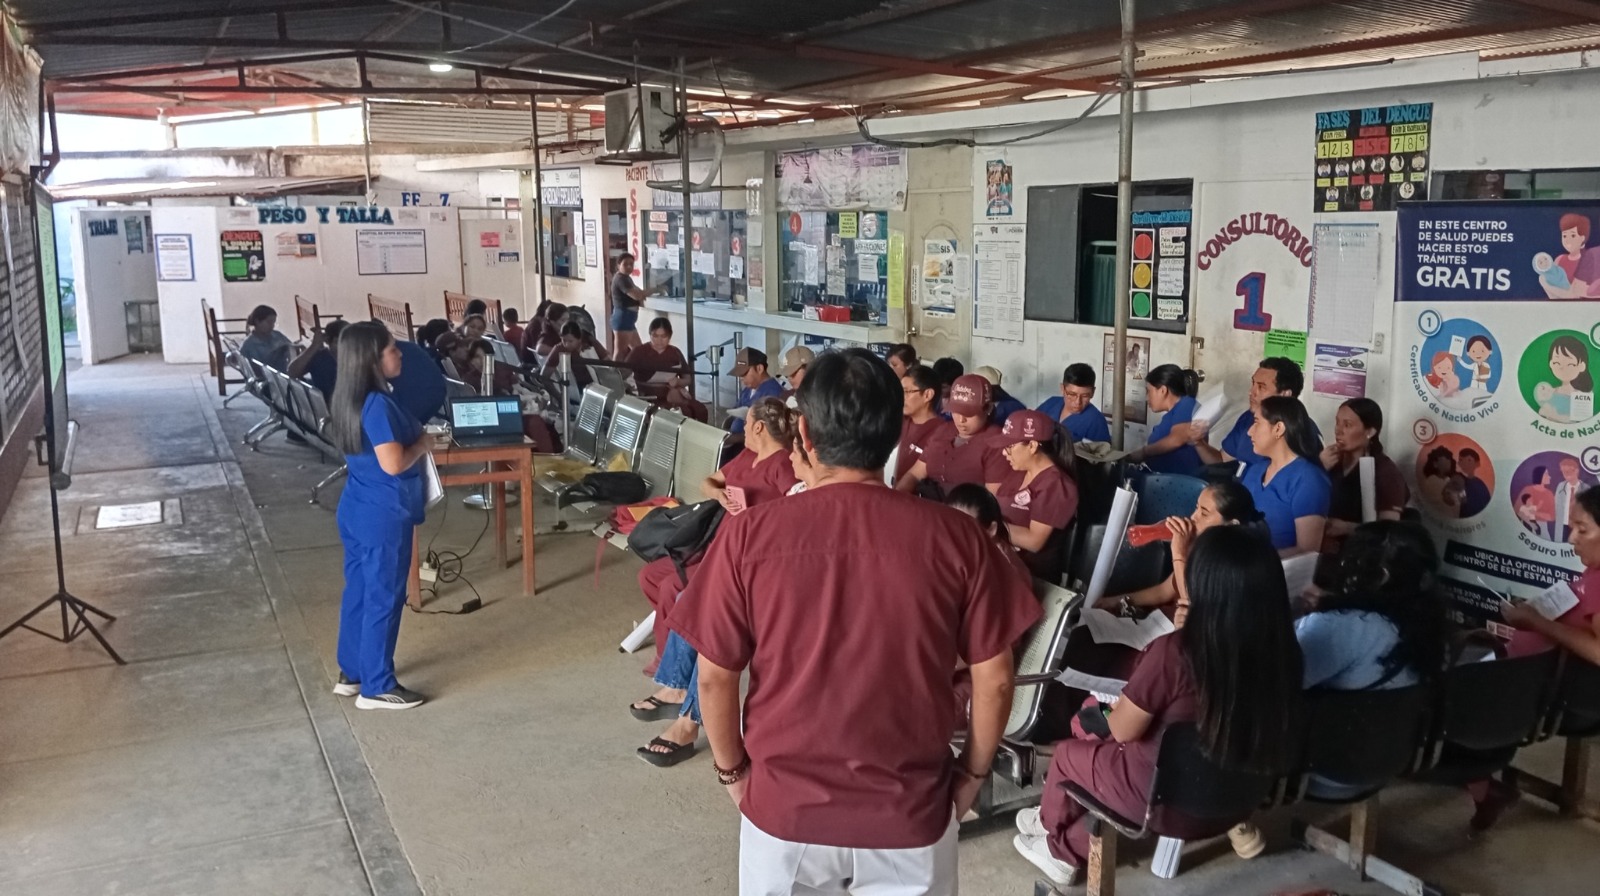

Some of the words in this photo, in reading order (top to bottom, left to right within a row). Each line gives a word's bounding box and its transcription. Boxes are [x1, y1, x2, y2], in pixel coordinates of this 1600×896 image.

[1317, 110, 1350, 129] FASES
[1360, 108, 1382, 126] DEL
[1386, 104, 1430, 123] DENGUE
[1322, 143, 1326, 156] 1
[1332, 143, 1338, 156] 2
[1344, 143, 1350, 154] 3
[1394, 138, 1400, 150] 7
[1408, 138, 1414, 149] 8
[1420, 135, 1425, 146] 9
[626, 166, 648, 182] PACIENTE
[258, 206, 306, 224] PESO
[316, 206, 330, 224] Y
[336, 206, 394, 225] TALLA
[792, 217, 797, 232] 4
[88, 219, 118, 236] TRIAJE
[1419, 220, 1432, 229] EN
[1435, 220, 1460, 230] ESTE
[1462, 220, 1507, 230] CENTRO
[692, 232, 700, 250] 2
[732, 237, 740, 255] 3
[1197, 212, 1313, 270] CONSULTORIO
[1418, 232, 1432, 240] DE
[1434, 232, 1468, 242] SALUD
[1471, 232, 1514, 242] PUEDES
[1418, 244, 1452, 252] HACER
[1455, 244, 1488, 254] ESTOS
[1417, 254, 1466, 264] TRÁMITES
[1416, 266, 1511, 291] GRATIS
[1234, 272, 1272, 332] 1
[1426, 317, 1432, 328] 1
[1410, 345, 1428, 402] Certificado
[1428, 402, 1440, 414] de
[1442, 410, 1476, 422] Nacido
[1477, 402, 1499, 418] Vivo
[1419, 426, 1427, 436] 3
[1530, 420, 1556, 436] Acta
[1560, 429, 1574, 438] de
[1590, 455, 1598, 466] 4
[1518, 532, 1556, 557] Seguro
[1454, 553, 1486, 567] DENTRO
[1488, 562, 1498, 571] DE
[1500, 564, 1522, 576] ESTE
[1474, 550, 1500, 563] UBICA
[1502, 558, 1512, 566] LA
[1516, 560, 1552, 576] OFICINA
[1554, 570, 1570, 580] DEL
